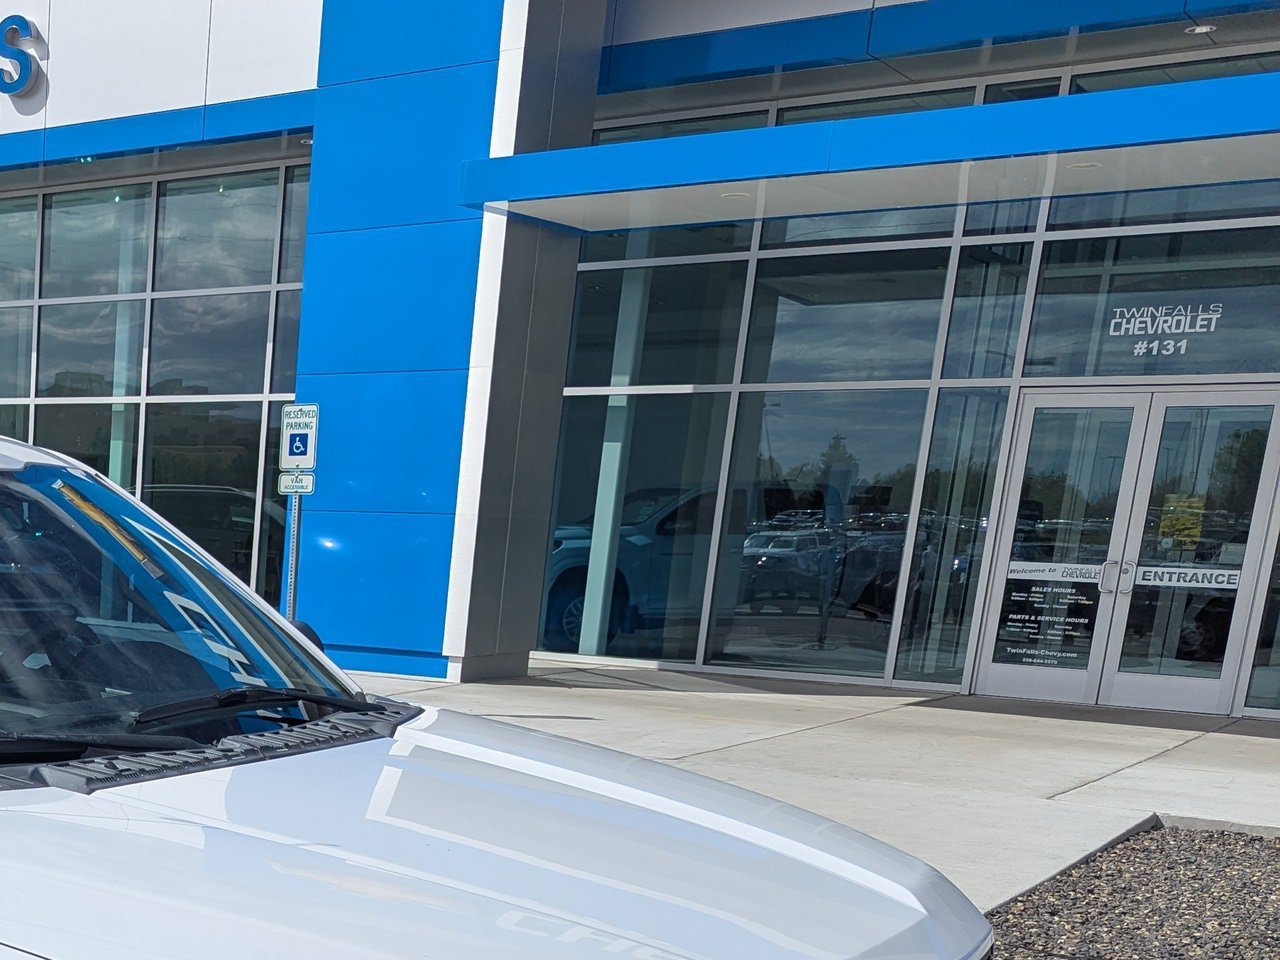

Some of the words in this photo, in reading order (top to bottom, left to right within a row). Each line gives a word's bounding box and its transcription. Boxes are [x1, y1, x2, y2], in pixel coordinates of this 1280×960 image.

[1113, 303, 1223, 318] TWINFALLS
[1109, 314, 1222, 336] CHEVROLET
[1133, 338, 1188, 357] #131
[284, 409, 317, 420] RESERVED
[285, 421, 314, 431] PARKING
[1141, 570, 1239, 585] ENTRANCE
[1007, 647, 1078, 657] TwinFalls-Chevy.com
